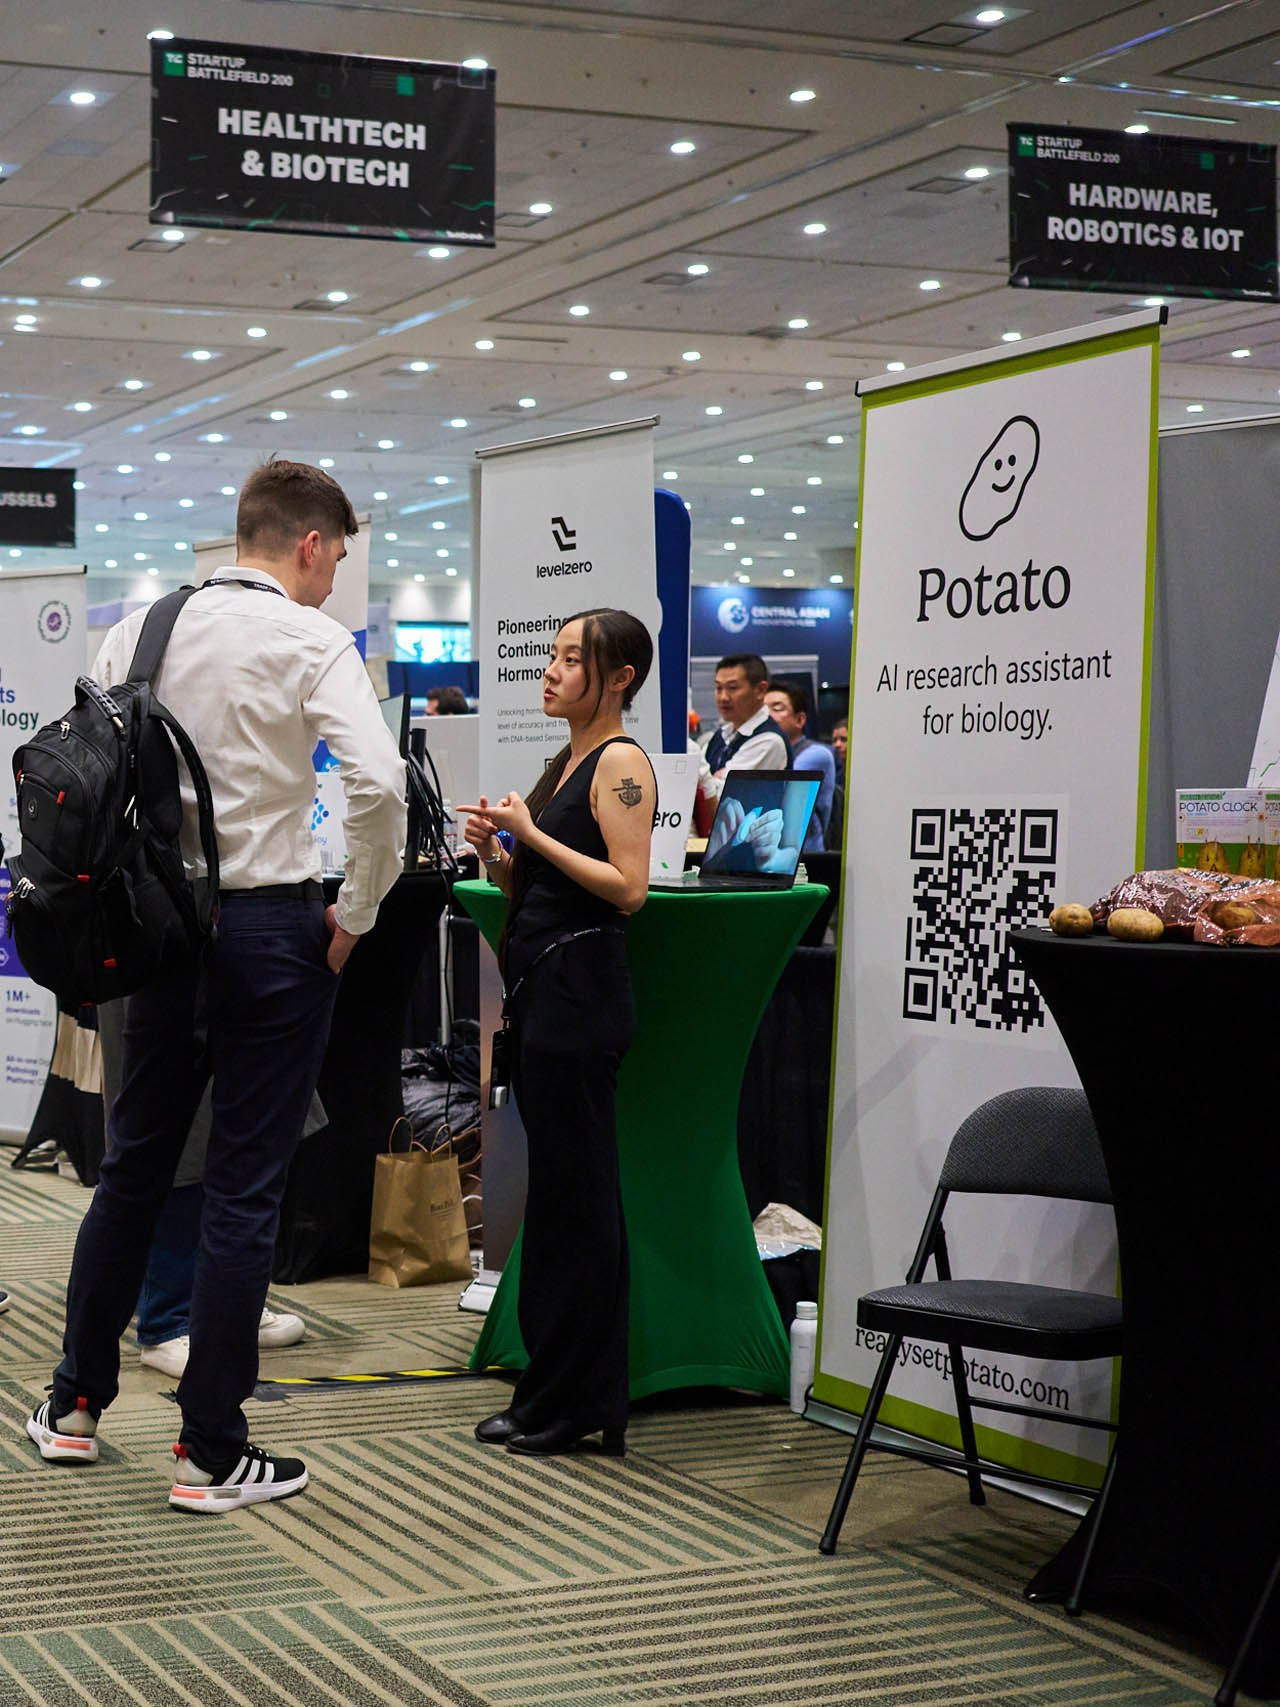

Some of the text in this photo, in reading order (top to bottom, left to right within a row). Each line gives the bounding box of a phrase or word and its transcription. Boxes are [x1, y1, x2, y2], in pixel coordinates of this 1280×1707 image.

[187, 53, 246, 69] STARTUP
[187, 67, 293, 87] BATTLEFIELD 200
[218, 108, 427, 151] HEALTHTECH
[1036, 136, 1083, 149] STARTUP
[241, 150, 409, 188] & BIOTECH
[1036, 148, 1120, 164] BATTLEFIELD 200
[1069, 183, 1218, 218] HARDWARE,
[1047, 216, 1244, 252] ROBOTICS & IOT
[536, 561, 593, 579] levelzero
[917, 559, 1071, 622] Potato
[498, 641, 555, 659] Continu
[877, 650, 1112, 692] AI research assistant
[923, 701, 1053, 740] for biology.
[1179, 802, 1258, 812] POTATO CLOCK
[856, 1328, 1069, 1410] reaysetptato.com
